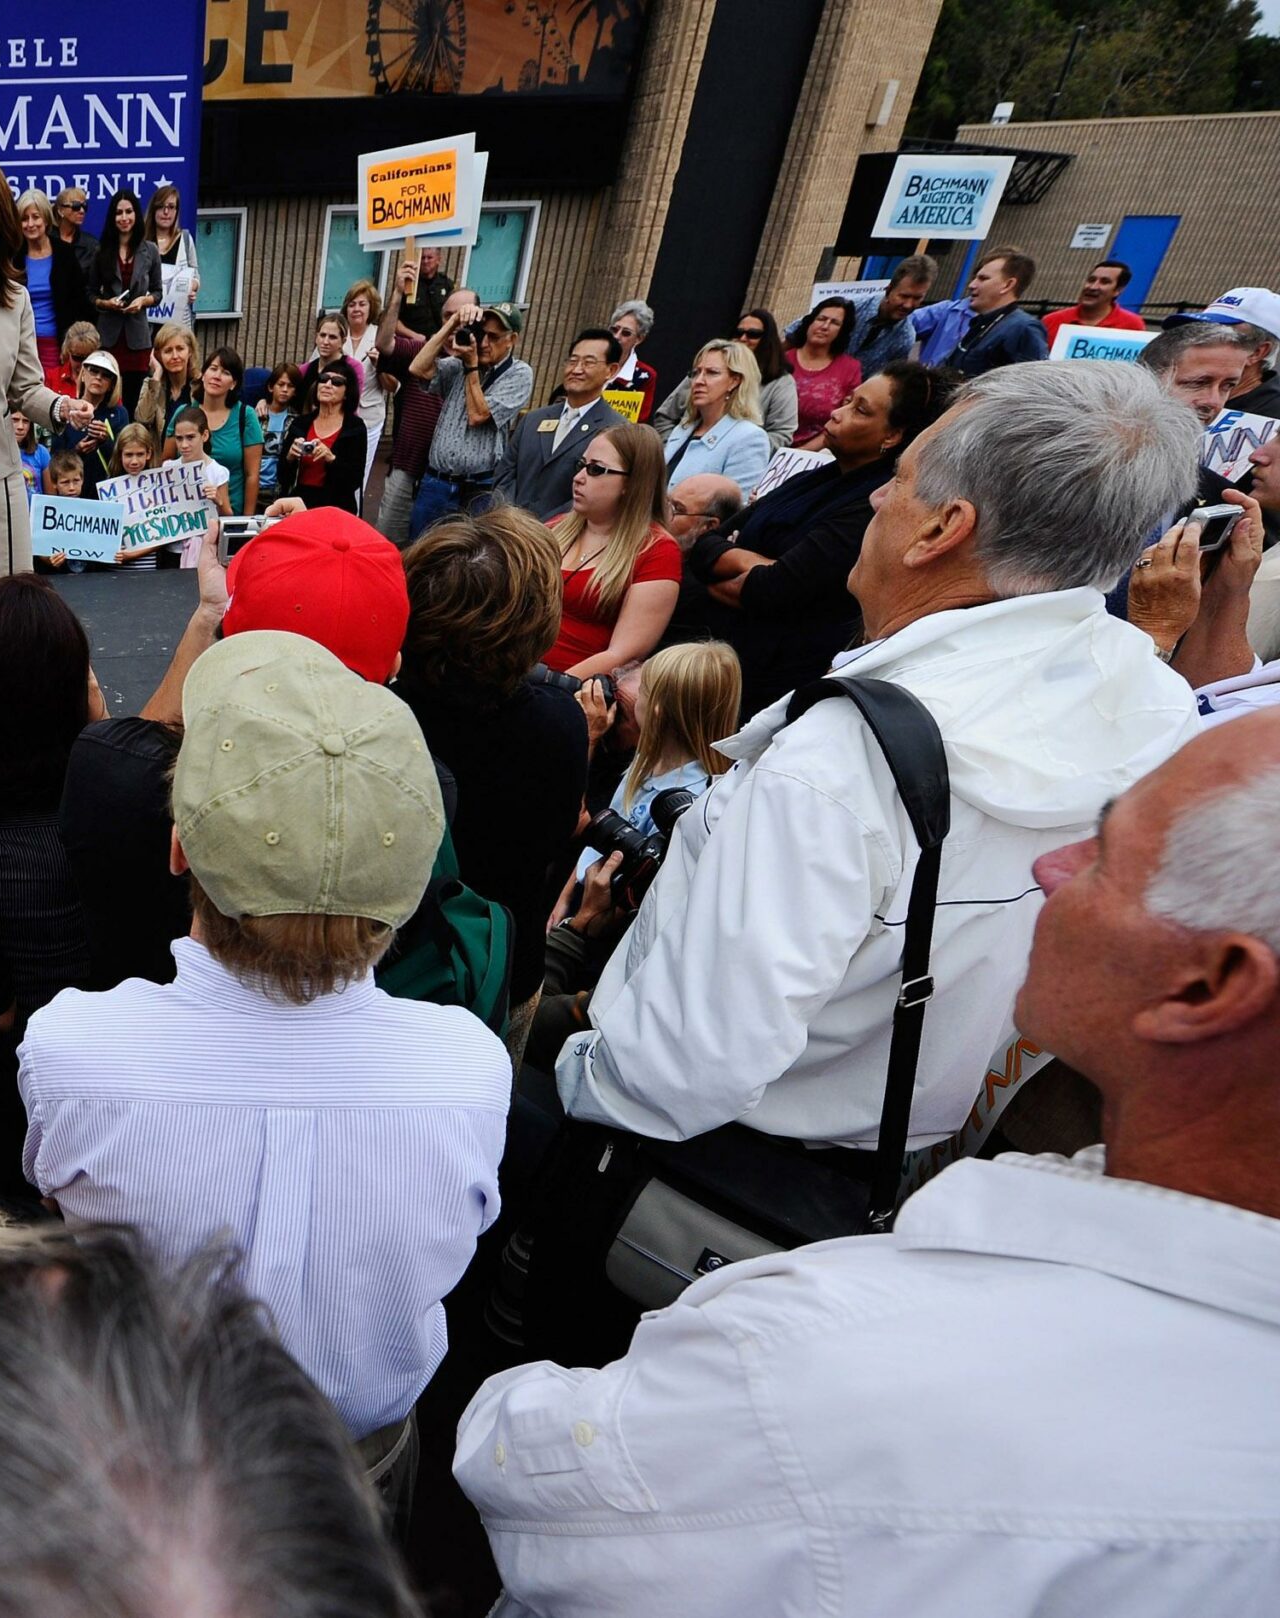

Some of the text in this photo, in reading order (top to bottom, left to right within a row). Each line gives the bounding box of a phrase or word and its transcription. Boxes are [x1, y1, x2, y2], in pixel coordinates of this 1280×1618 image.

[371, 162, 452, 183] Californians
[400, 184, 427, 197] FOR
[905, 175, 990, 197] BACHMANN
[372, 192, 451, 224] BACHMANN
[920, 191, 976, 205] RIGHT FOR
[897, 205, 975, 225] AMERICA
[42, 505, 120, 536] BACHMANN
[145, 506, 167, 518] FOR
[51, 547, 104, 559] NOW
